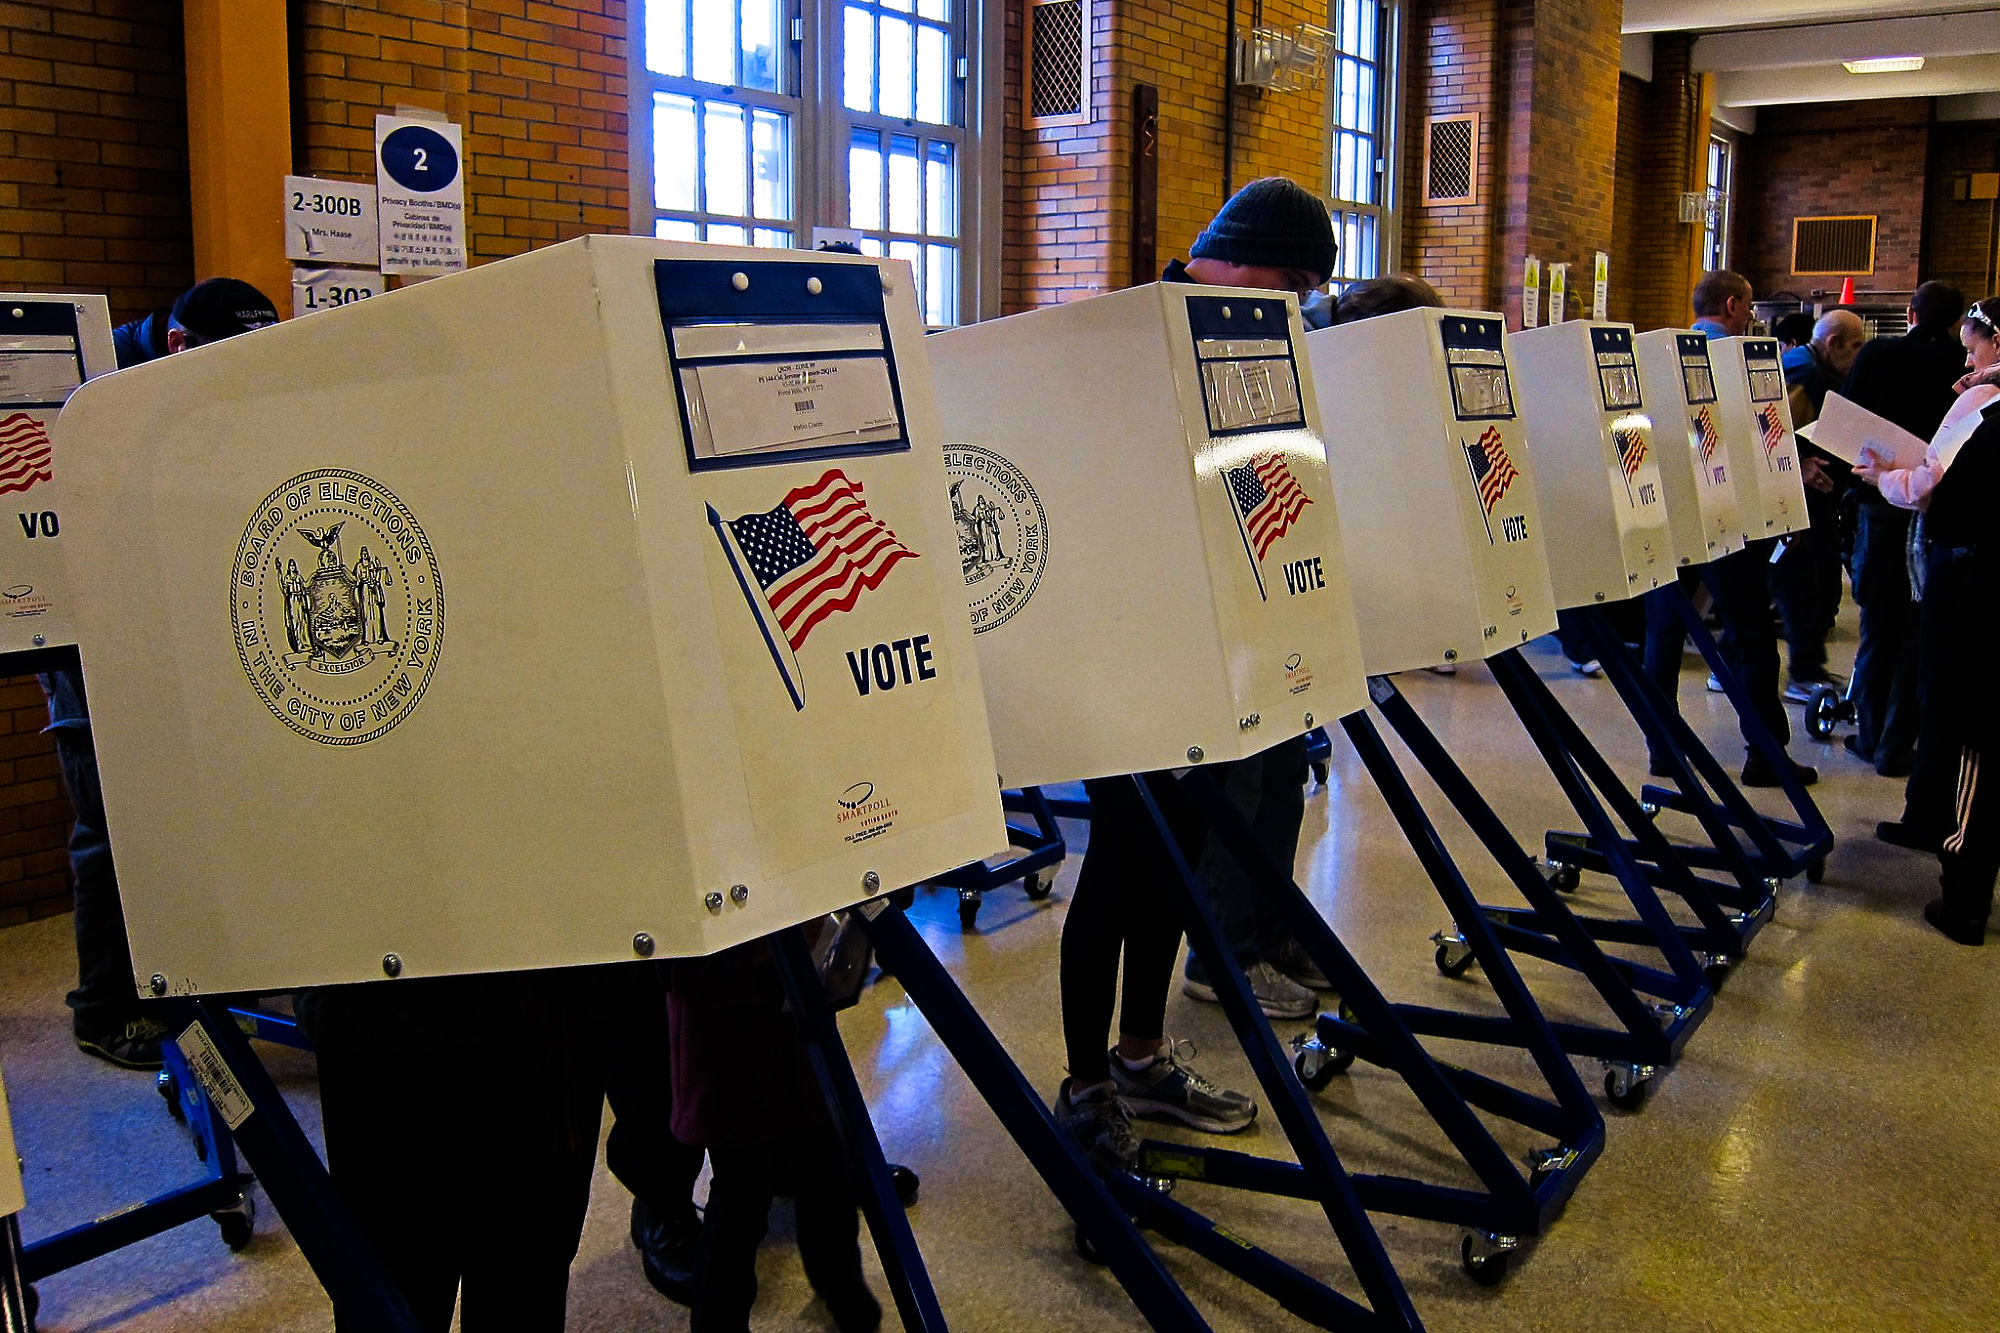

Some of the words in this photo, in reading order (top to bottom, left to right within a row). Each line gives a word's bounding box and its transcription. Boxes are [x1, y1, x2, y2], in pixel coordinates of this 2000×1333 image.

[413, 148, 428, 171] 2
[292, 192, 361, 216] 2-300B
[382, 196, 407, 207] Privacy
[404, 213, 430, 221] Cabinas
[311, 228, 329, 238] Mrs.
[330, 229, 352, 239] Haase
[1712, 465, 1727, 485] VOTE
[1776, 456, 1792, 472] VOTE
[1638, 483, 1656, 506] VOTE
[18, 510, 60, 539] VO
[241, 508, 284, 588] BOARD
[286, 485, 312, 511] OF
[318, 481, 423, 565] ELECTIONS
[1502, 515, 1528, 542] VOTE
[992, 578, 1026, 615] NEW
[1020, 523, 1039, 574] YORK
[1283, 556, 1326, 596] VOTE
[242, 620, 259, 647] IN
[252, 651, 286, 700] THE
[286, 697, 336, 731] CITY
[339, 709, 366, 731] OF
[370, 672, 413, 722] NEW
[407, 597, 433, 670] YORK
[318, 657, 365, 673] EXCELSIOR
[845, 633, 937, 697] VOTE
[836, 798, 891, 823] SMARTPOLL
